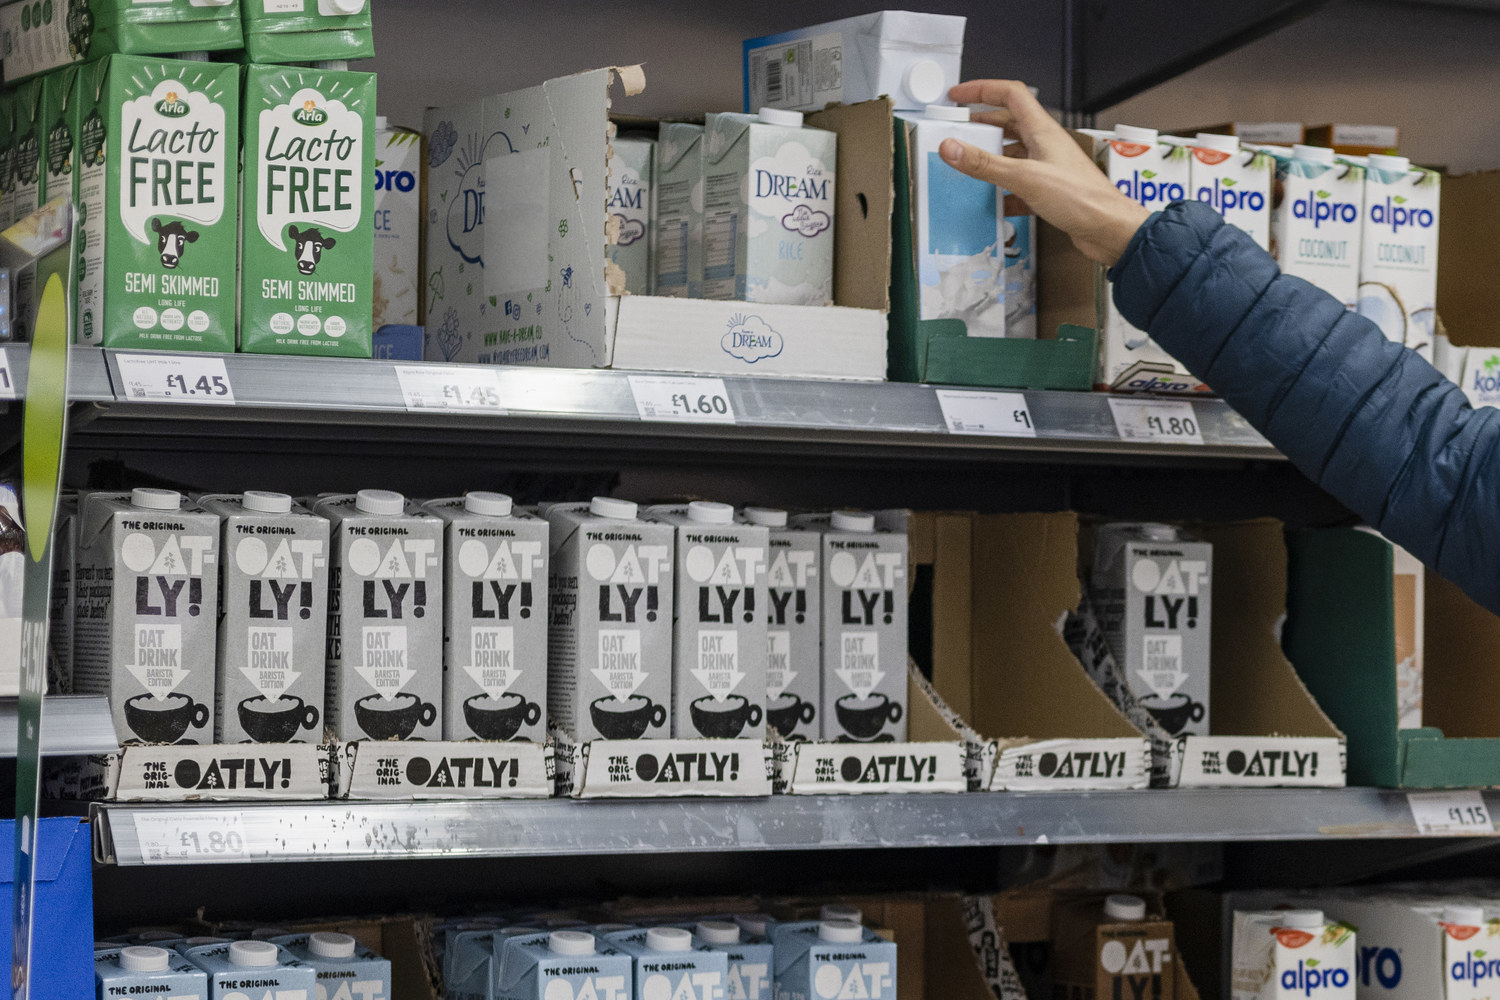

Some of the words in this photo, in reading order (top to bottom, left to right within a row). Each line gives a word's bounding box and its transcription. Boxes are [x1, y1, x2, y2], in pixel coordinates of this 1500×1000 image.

[159, 102, 186, 115] Arla
[297, 109, 324, 123] Arla
[128, 117, 218, 155] Lacto
[265, 125, 357, 162] Lacto
[129, 158, 216, 208] FREE
[267, 165, 352, 215] FREE
[755, 169, 828, 201] DREAM
[1115, 170, 1185, 206] alpro
[1292, 190, 1358, 228] alpro
[1299, 238, 1348, 261] COCONUT
[125, 273, 156, 294] SEMI
[161, 275, 219, 298] SKIMMED
[158, 299, 172, 307] LONG
[174, 300, 186, 308] LIFE
[732, 331, 772, 350] DREAM
[166, 374, 228, 396] £1.45
[442, 382, 502, 406] £1.45
[1129, 377, 1189, 392] alpro
[672, 393, 728, 415] £1.60
[1013, 409, 1031, 430] £1
[1148, 415, 1196, 437] £1.80
[122, 520, 142, 530] THE
[143, 520, 186, 532] ORIGINAL
[458, 528, 476, 538] THE
[476, 528, 516, 538] ORIGINAL
[136, 576, 203, 618] LY!
[472, 580, 533, 620] LY!
[138, 629, 165, 648] OAT
[475, 631, 500, 650] OAT
[475, 649, 511, 668] DRINK
[146, 668, 174, 680] BARISTA
[148, 677, 173, 688] EDITION
[174, 757, 292, 791] OATLY!
[635, 752, 740, 783] OATLY!
[1038, 750, 1126, 779] OATLY!
[1226, 748, 1318, 778] OATLY!
[144, 772, 174, 781] ORIG-
[146, 780, 170, 789] INAL
[1448, 806, 1487, 826] £1.15
[180, 830, 244, 854] £1.80
[544, 967, 560, 976] THE
[562, 966, 600, 976] ORIGINAL
